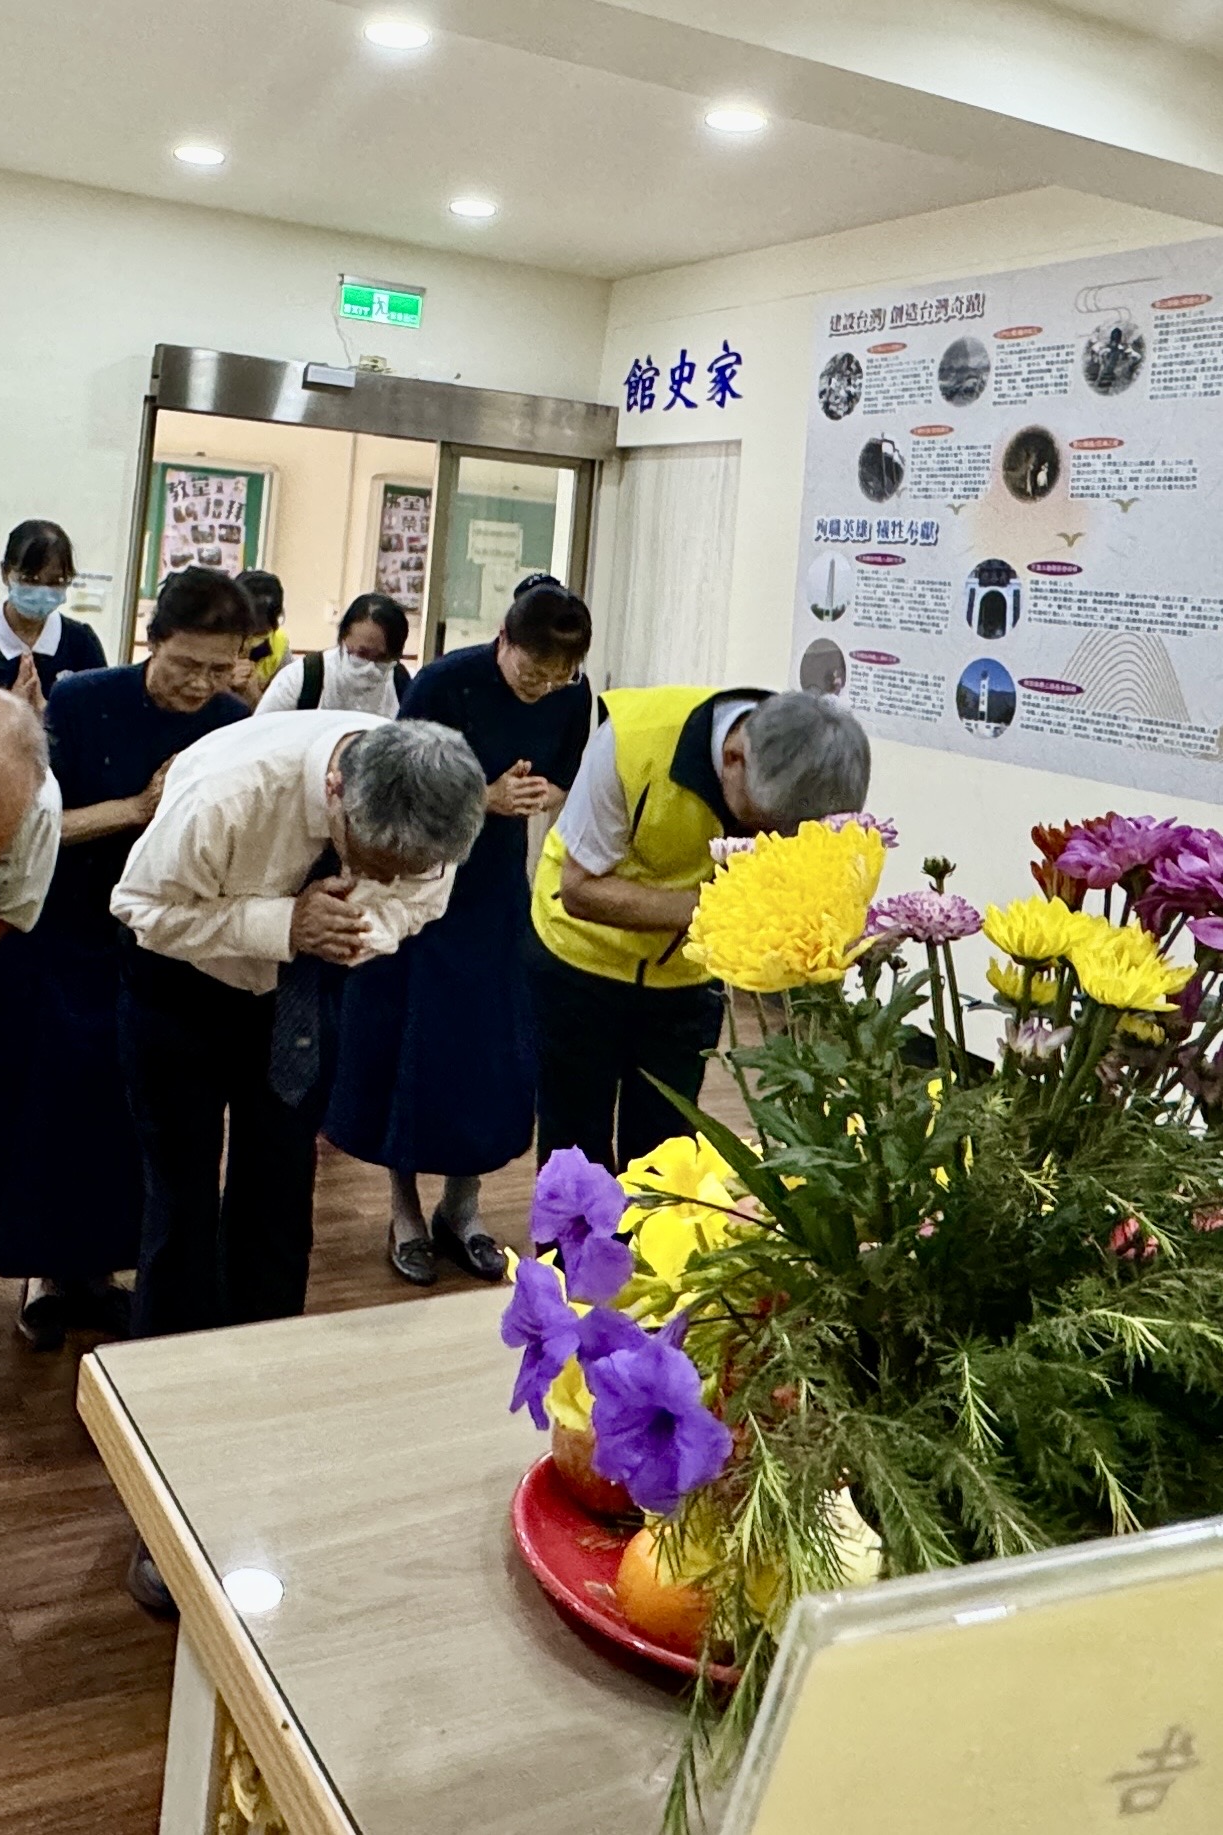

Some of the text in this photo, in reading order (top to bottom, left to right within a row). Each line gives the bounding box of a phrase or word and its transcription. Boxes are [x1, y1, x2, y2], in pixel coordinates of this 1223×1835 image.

[830, 307, 886, 335] 建設台灣
[876, 519, 939, 545] 犧牲奉獻
